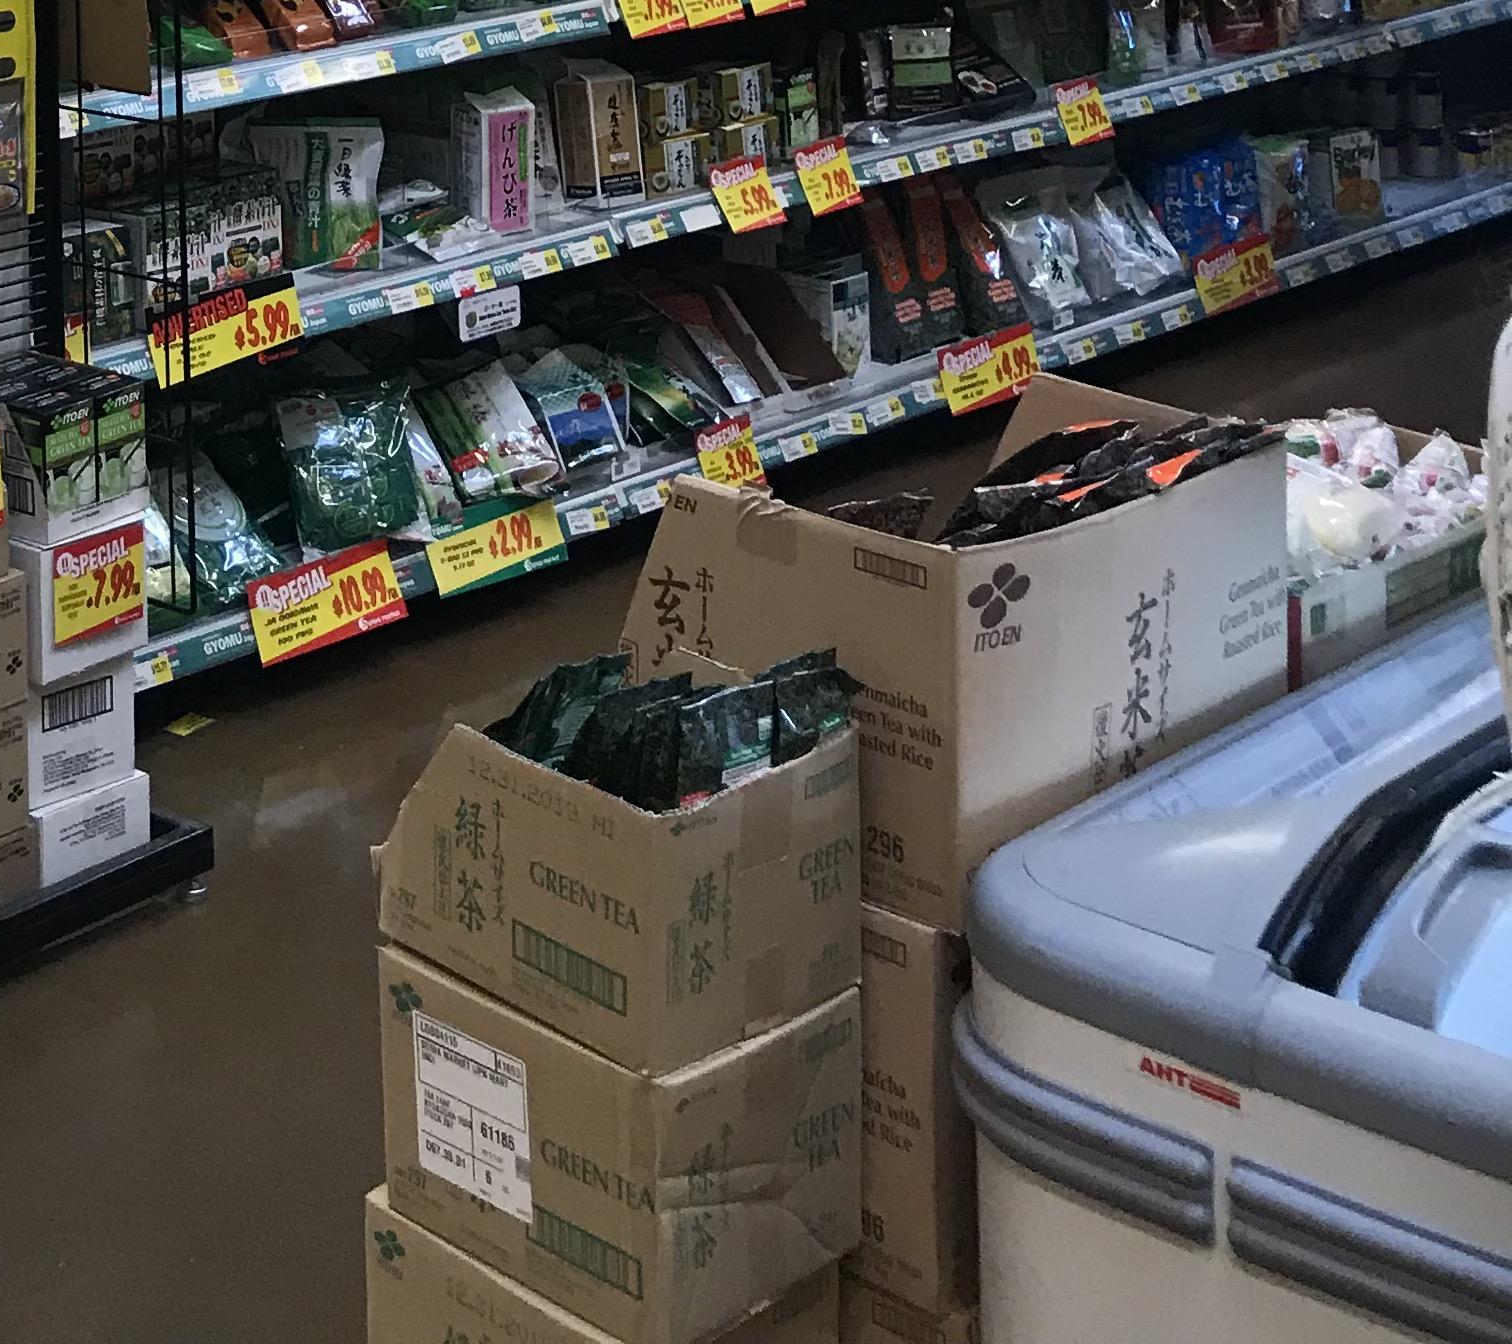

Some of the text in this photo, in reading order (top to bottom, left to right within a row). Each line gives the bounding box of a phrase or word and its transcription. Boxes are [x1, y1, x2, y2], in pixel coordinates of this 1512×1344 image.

[486, 29, 519, 45] GYOMU
[235, 300, 289, 350] $5.99
[348, 296, 385, 316] GYOMU
[72, 536, 130, 579] SPECIAL
[273, 565, 333, 612] SPECIAL
[203, 632, 242, 656] GYOMU
[848, 681, 929, 718] enmaicha
[879, 710, 943, 748] Tea with
[901, 743, 934, 771] Rice
[455, 793, 486, 932] 緑茶
[799, 832, 855, 883] GREEN
[866, 825, 905, 864] 296
[529, 861, 639, 934] GREEN TEA
[810, 874, 843, 905] TEA
[793, 1102, 855, 1153] GREEN
[886, 1102, 921, 1130] with
[880, 1123, 914, 1153] Rice
[540, 1137, 655, 1214] GREEN TEA
